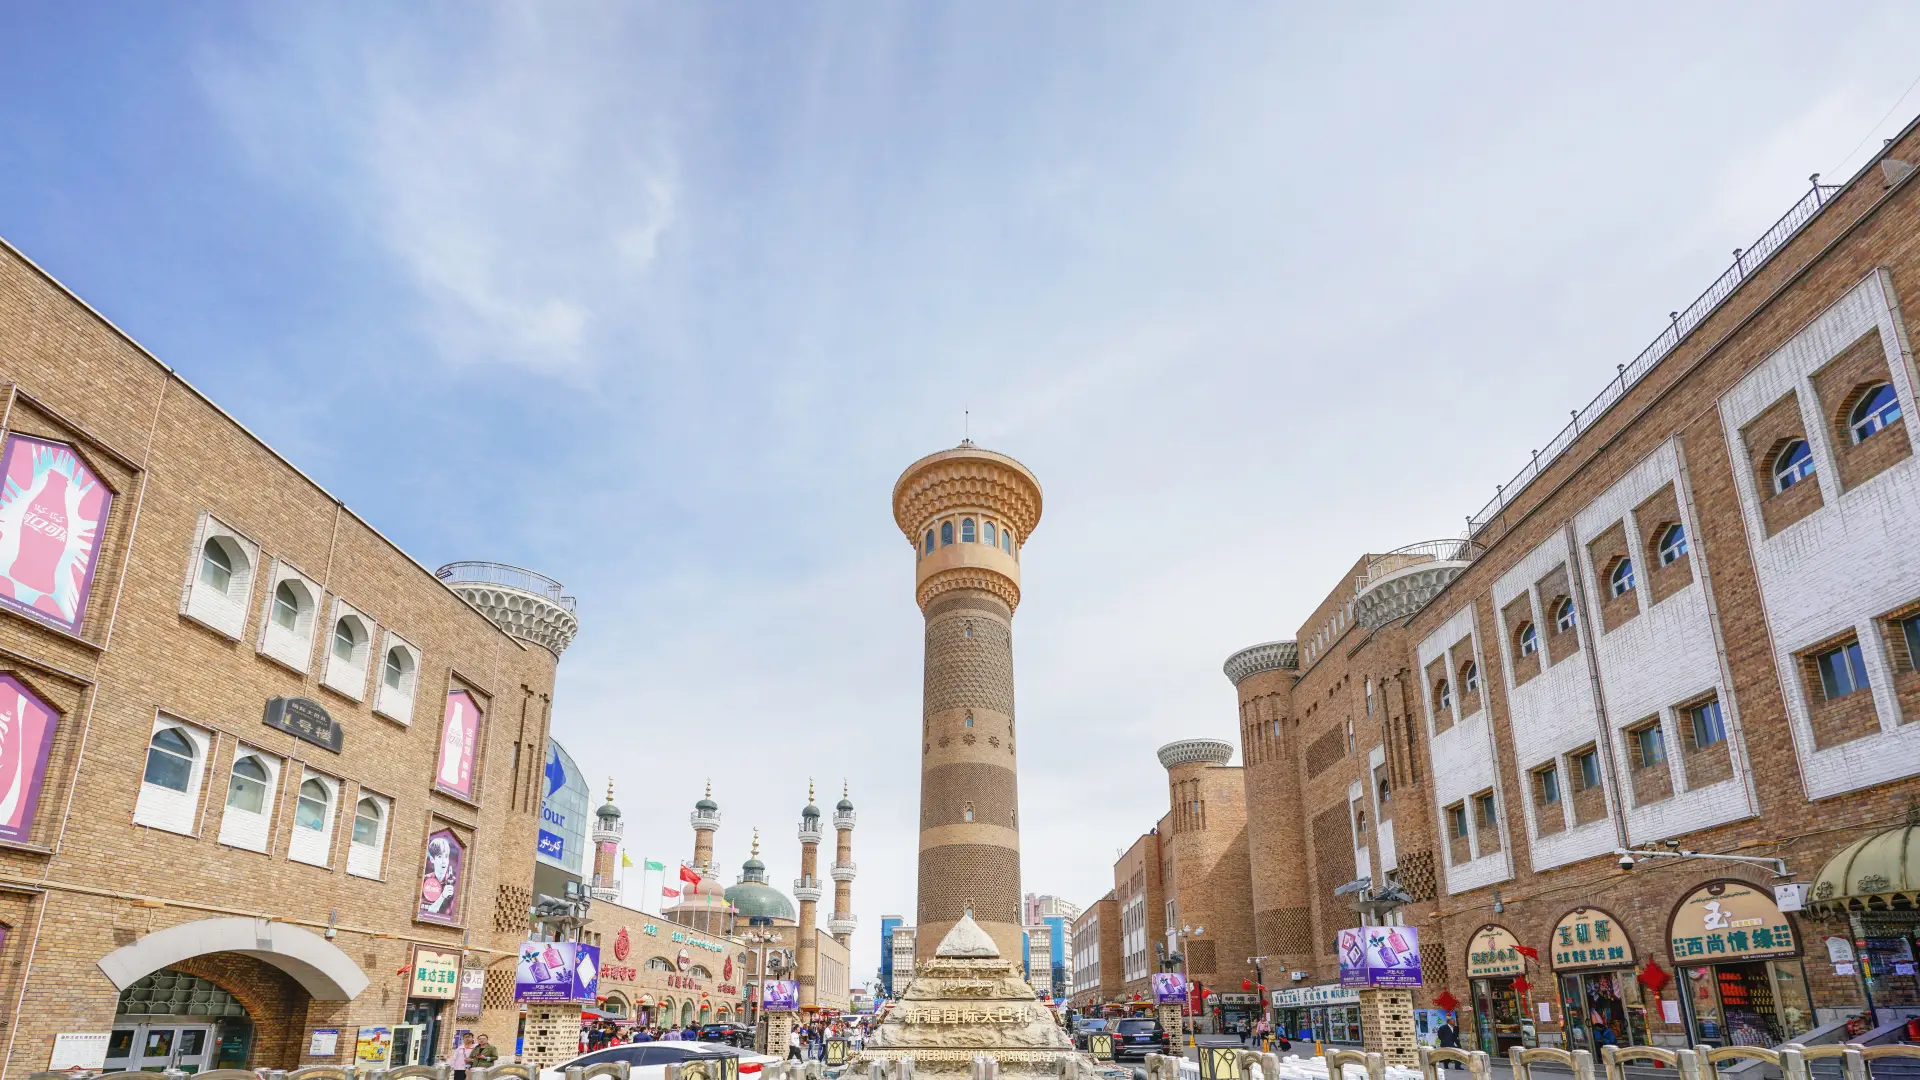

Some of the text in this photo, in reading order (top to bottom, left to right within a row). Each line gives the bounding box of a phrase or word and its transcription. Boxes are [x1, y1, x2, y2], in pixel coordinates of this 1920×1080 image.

[1702, 901, 1732, 931] 玉
[1685, 928, 1776, 956] 西尚情缘
[905, 1007, 1032, 1024] 新疆国际大巴扎
[993, 1051, 1030, 1062] GRAND
